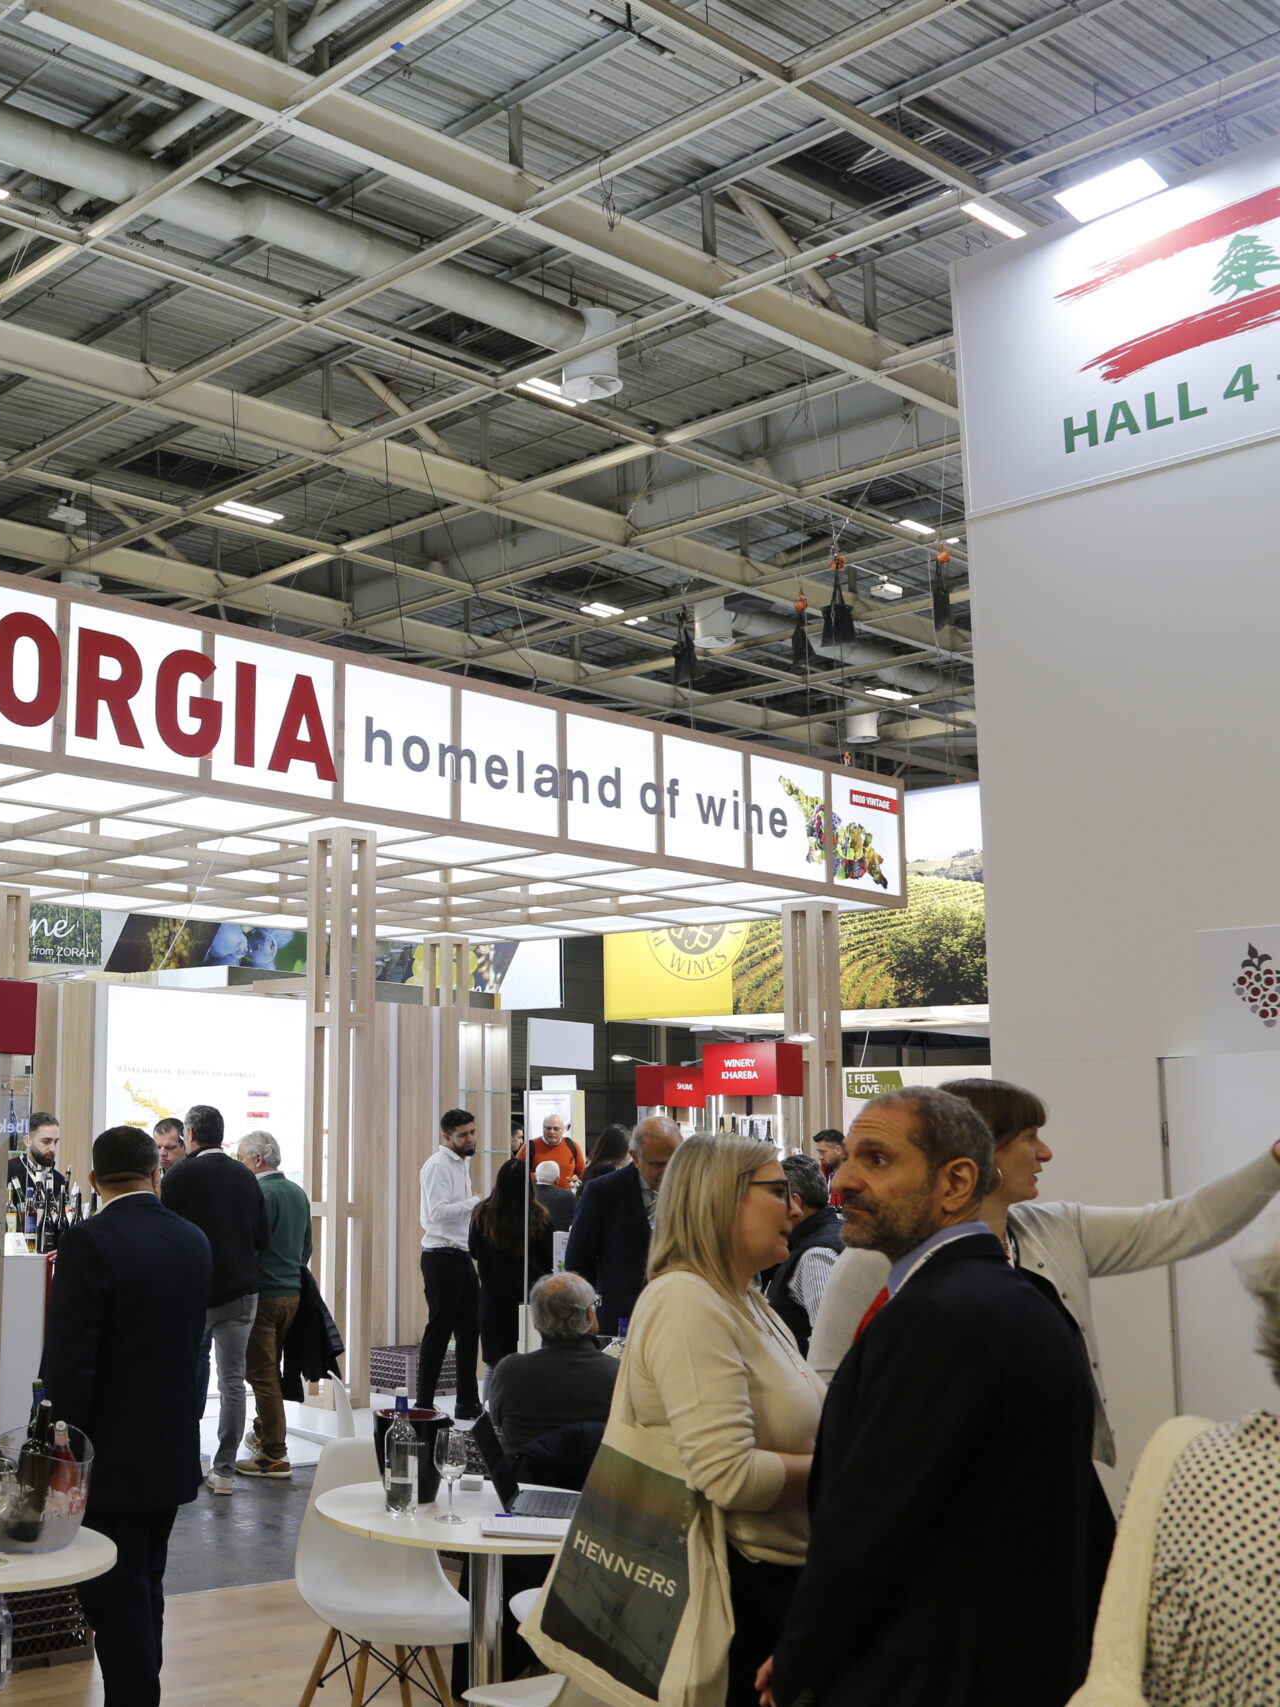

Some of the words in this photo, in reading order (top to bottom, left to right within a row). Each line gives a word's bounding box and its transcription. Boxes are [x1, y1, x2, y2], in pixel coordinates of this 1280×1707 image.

[1063, 382, 1208, 454] HALL
[1222, 363, 1260, 403] 4
[364, 716, 620, 809] homeland
[640, 778, 680, 820] of
[697, 790, 789, 839] wine
[33, 945, 54, 956] from
[56, 946, 94, 958] ZORAH
[670, 949, 727, 975] WINES
[724, 1058, 756, 1068] WINERY
[721, 1070, 759, 1080] KHAREBA
[848, 1074, 853, 1083] I
[854, 1073, 878, 1083] FEEL
[573, 1530, 677, 1598] HENNERS
